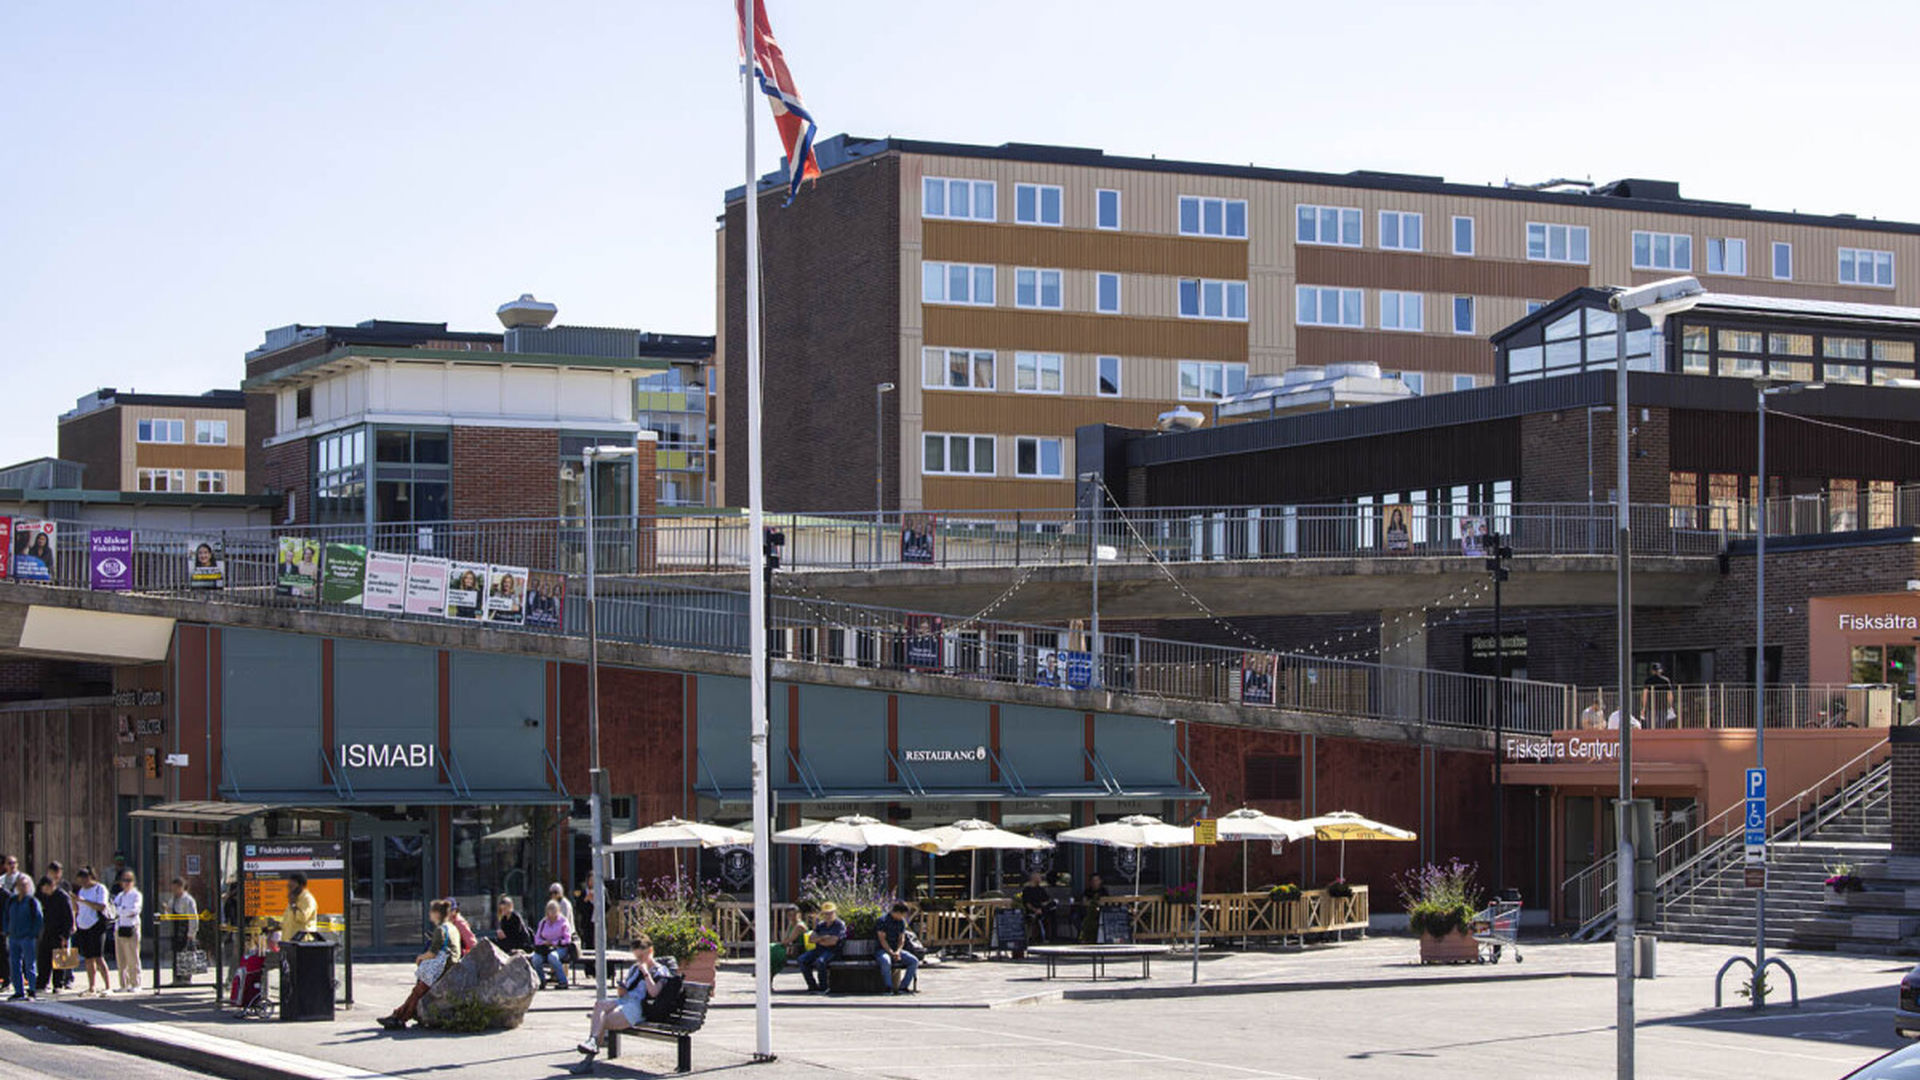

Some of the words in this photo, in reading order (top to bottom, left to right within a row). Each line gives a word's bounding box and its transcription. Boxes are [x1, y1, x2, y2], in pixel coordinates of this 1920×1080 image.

[92, 536, 102, 544] Vi
[103, 535, 129, 544] älskar
[1839, 613, 1918, 630] Fisksätra
[341, 744, 434, 767] ISMABI
[905, 750, 975, 761] RESTAURANG
[1751, 771, 1763, 796] P
